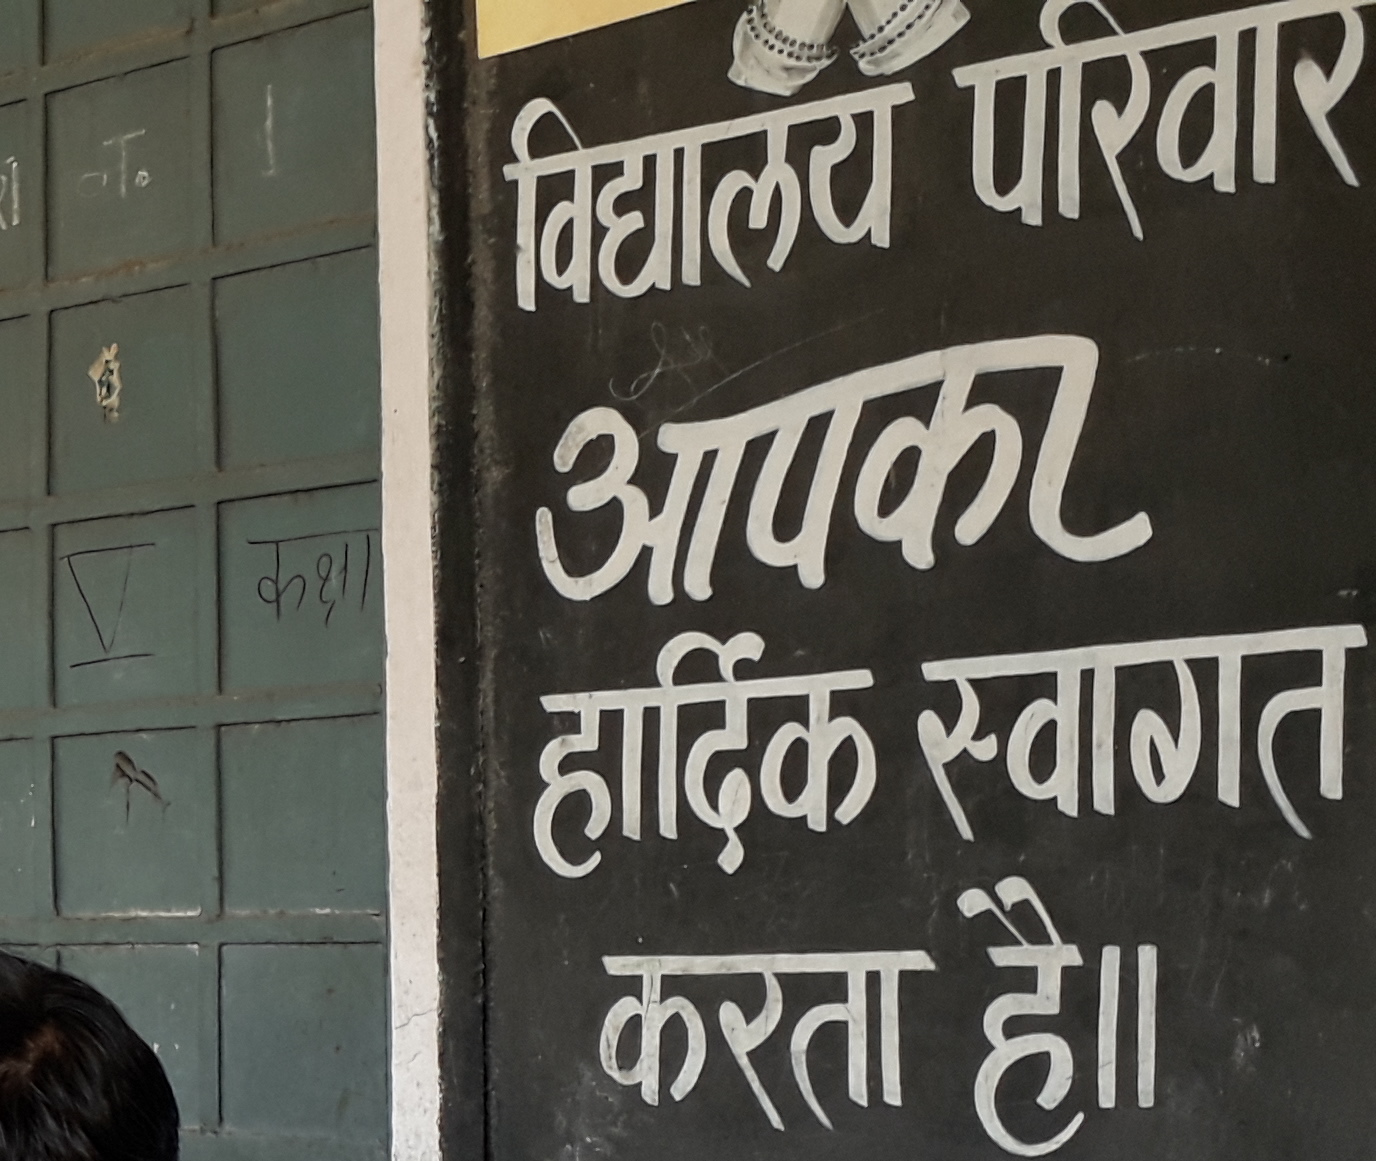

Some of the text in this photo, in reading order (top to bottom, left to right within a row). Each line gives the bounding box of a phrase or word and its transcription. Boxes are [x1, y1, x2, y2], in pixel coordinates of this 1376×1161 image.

[503, 0, 1376, 312] विद्यालय परिवार
[535, 333, 1153, 606] आपका
[533, 624, 1368, 878] हार्दिक स्वागत
[599, 949, 940, 1131] करता
